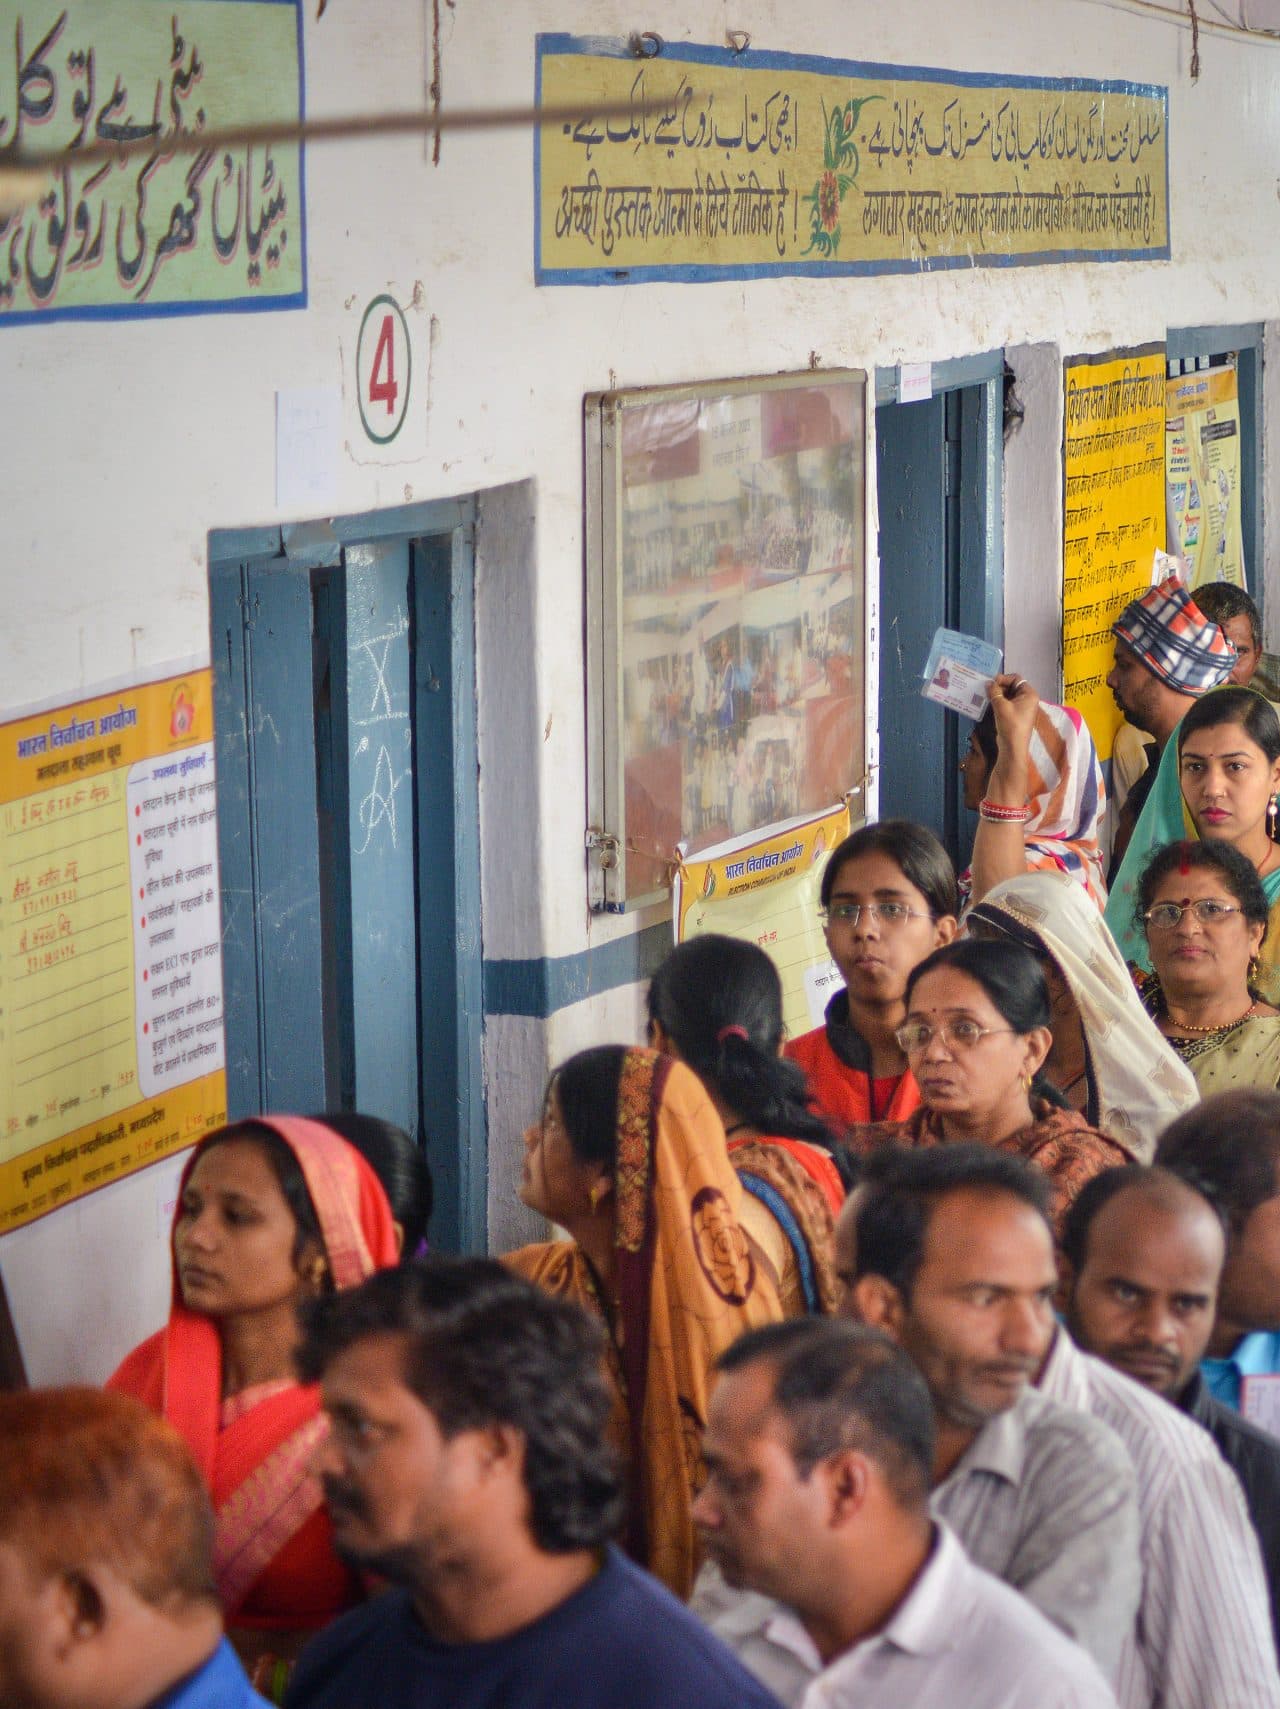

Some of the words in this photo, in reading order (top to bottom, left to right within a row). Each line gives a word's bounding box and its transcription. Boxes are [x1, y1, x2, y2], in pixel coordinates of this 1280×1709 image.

[602, 186, 653, 257] पुस्तक
[694, 168, 705, 238] के
[369, 315, 398, 416] 4
[17, 735, 49, 759] भारत
[50, 715, 97, 750] निर्वाचन
[99, 703, 138, 736] आयोग
[726, 861, 745, 882] भारत
[746, 851, 780, 876] निर्वाचन
[780, 841, 804, 865] आयोग
